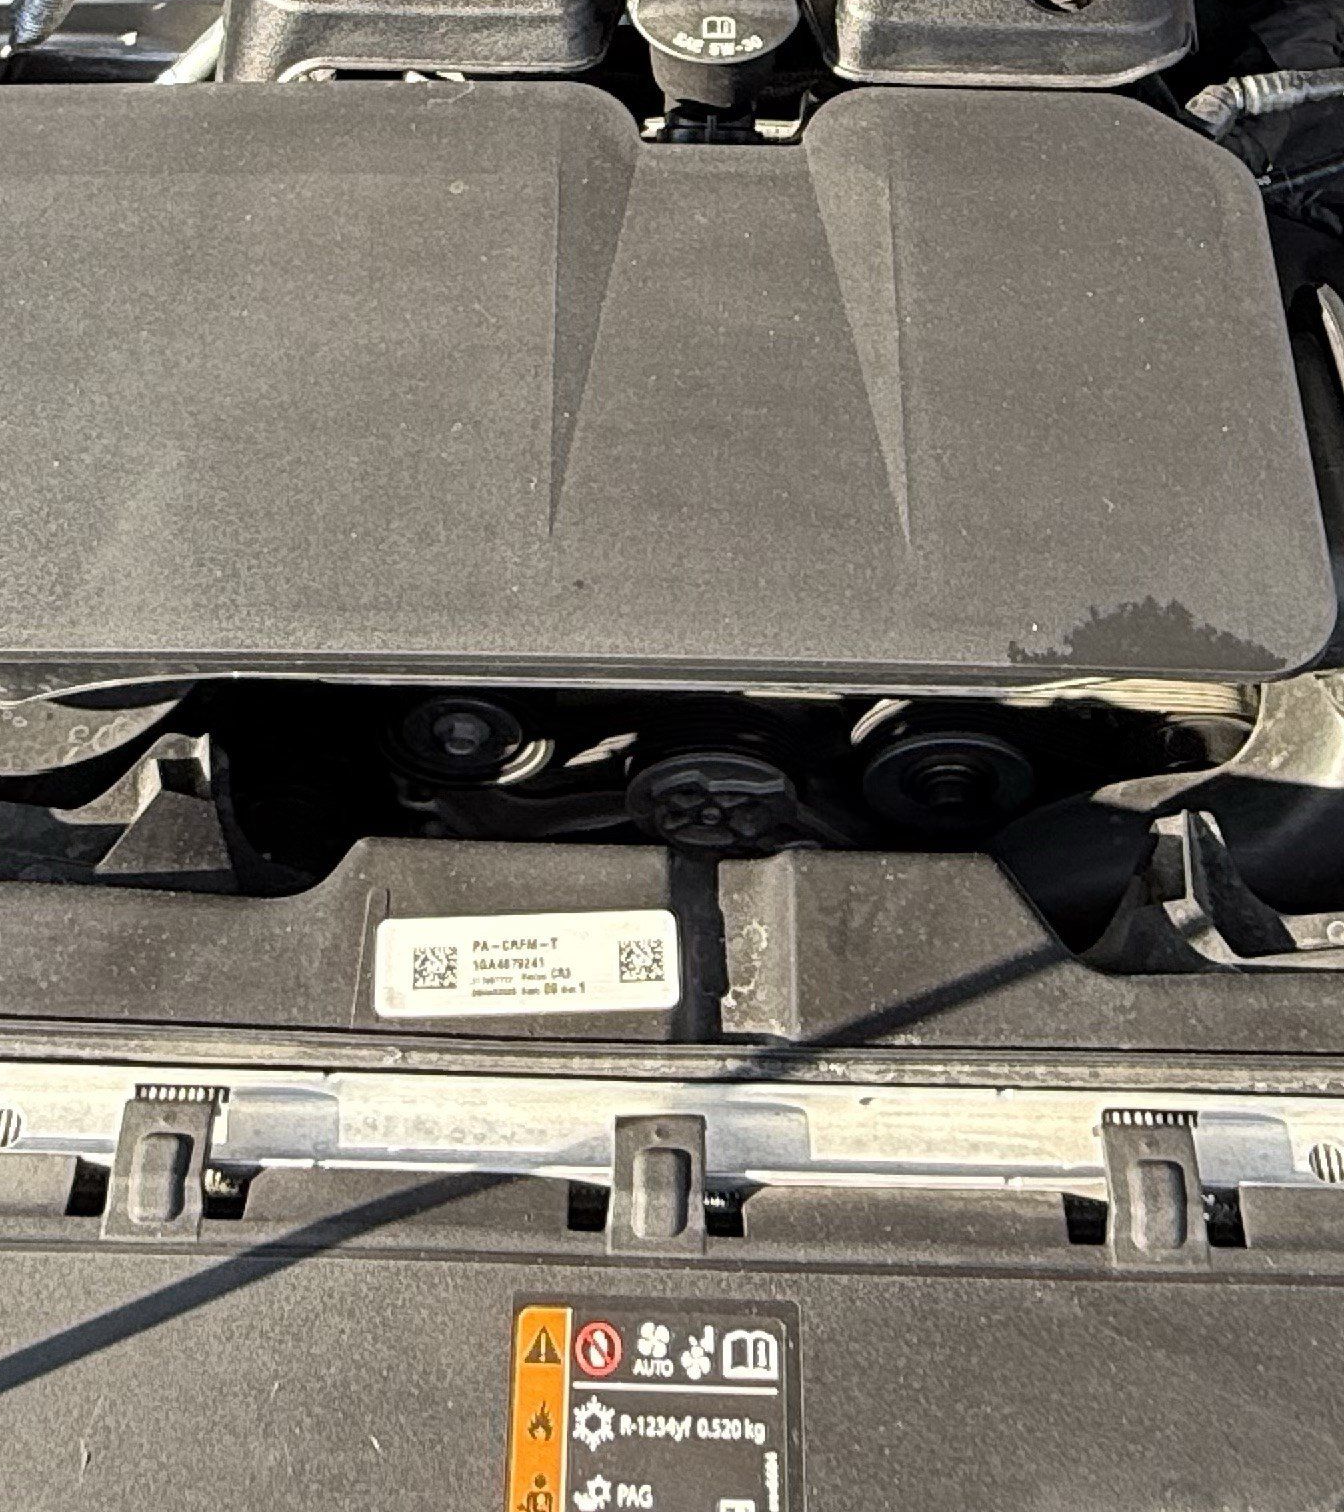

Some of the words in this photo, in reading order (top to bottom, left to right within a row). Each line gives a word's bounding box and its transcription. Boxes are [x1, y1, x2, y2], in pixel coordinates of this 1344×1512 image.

[632, 1358, 674, 1378] AUTO
[619, 1414, 693, 1442] R-1234yf
[696, 1417, 742, 1441] 0.520
[744, 1418, 767, 1445] kg
[616, 1482, 654, 1509] PAG
